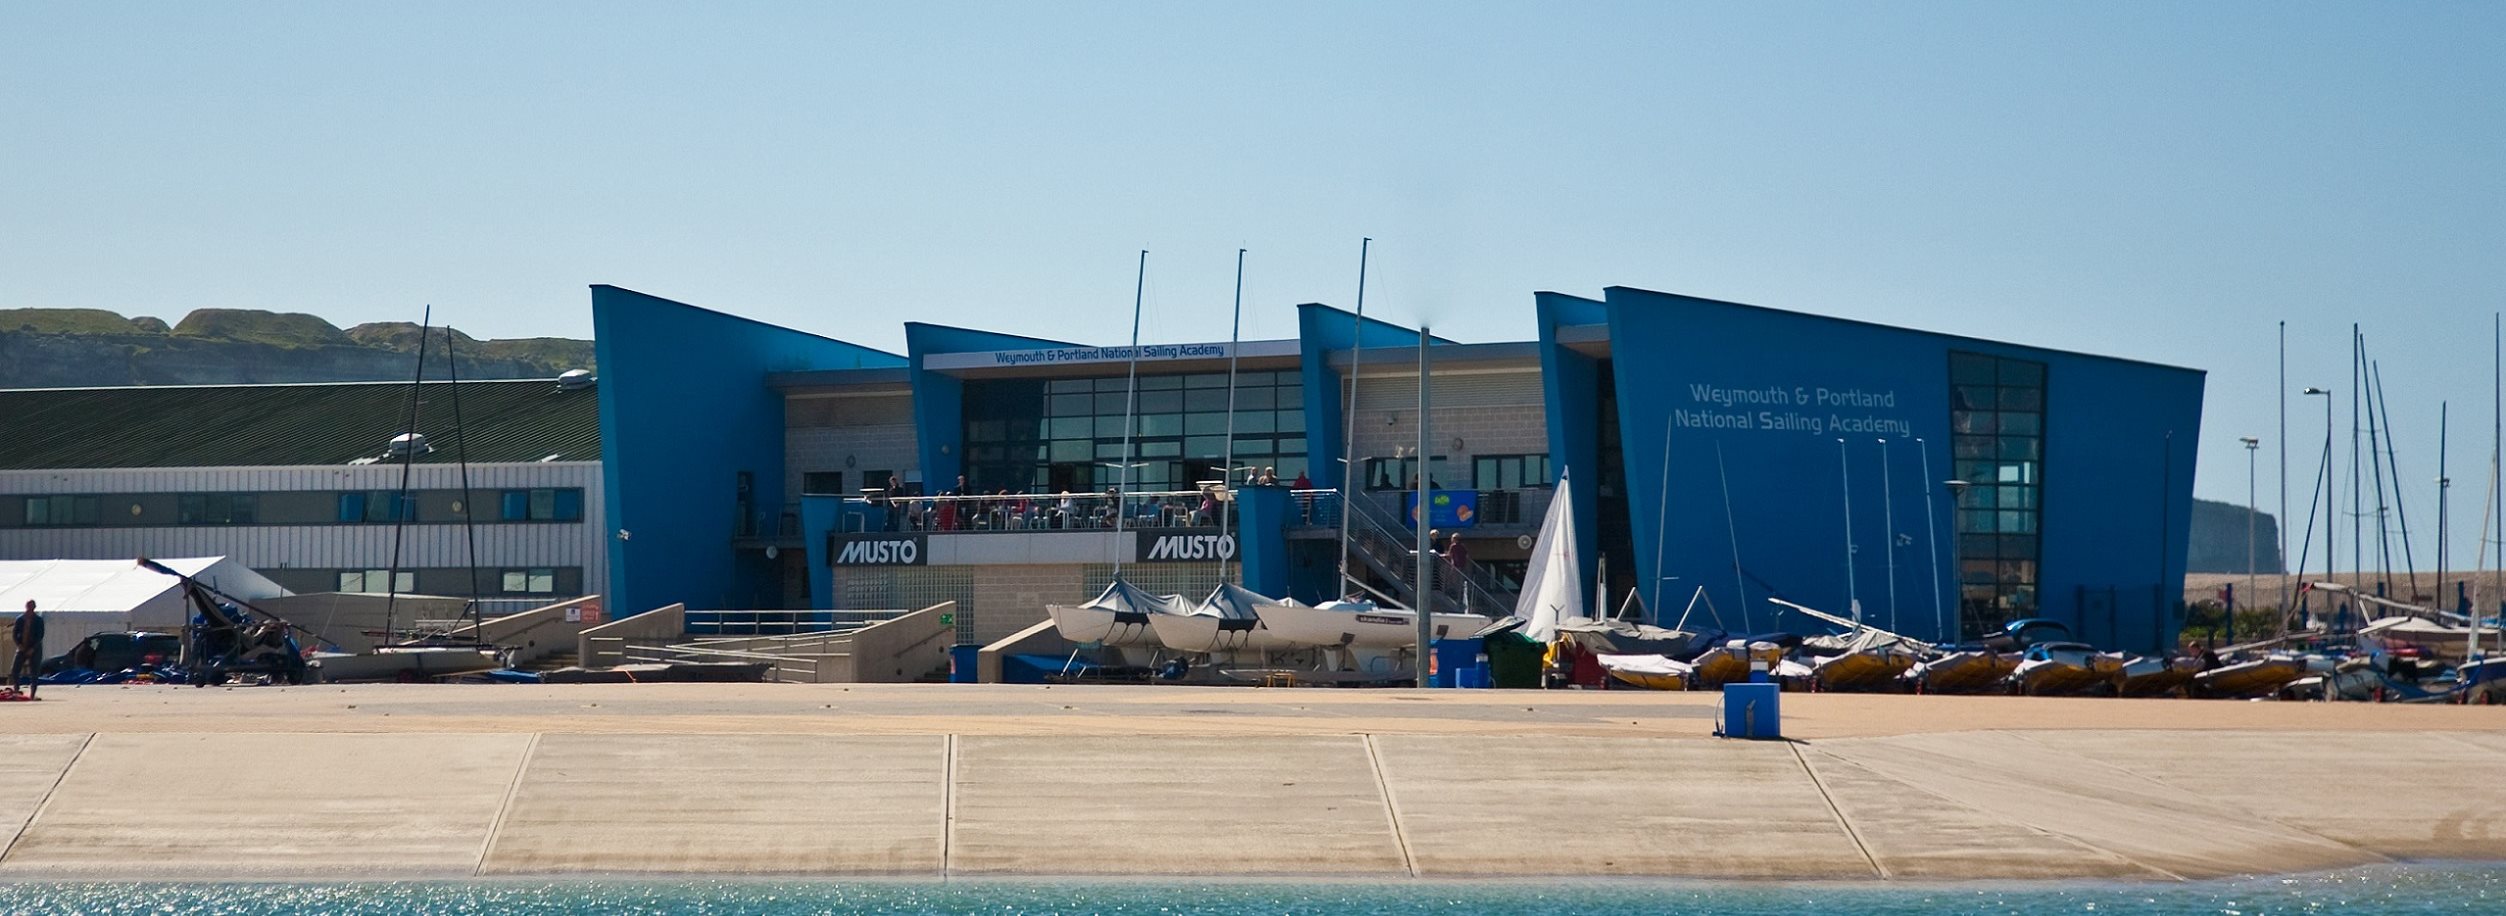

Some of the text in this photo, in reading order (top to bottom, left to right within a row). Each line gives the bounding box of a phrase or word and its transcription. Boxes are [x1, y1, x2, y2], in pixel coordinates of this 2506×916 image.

[995, 345, 1224, 365] Weymouth & Portland National Sailing Academy
[1689, 384, 1895, 408] Weymouth & Portland
[1675, 409, 1910, 438] National Sailing Academy
[837, 540, 917, 564] MUSTO
[1147, 534, 1235, 559] MUSTO
